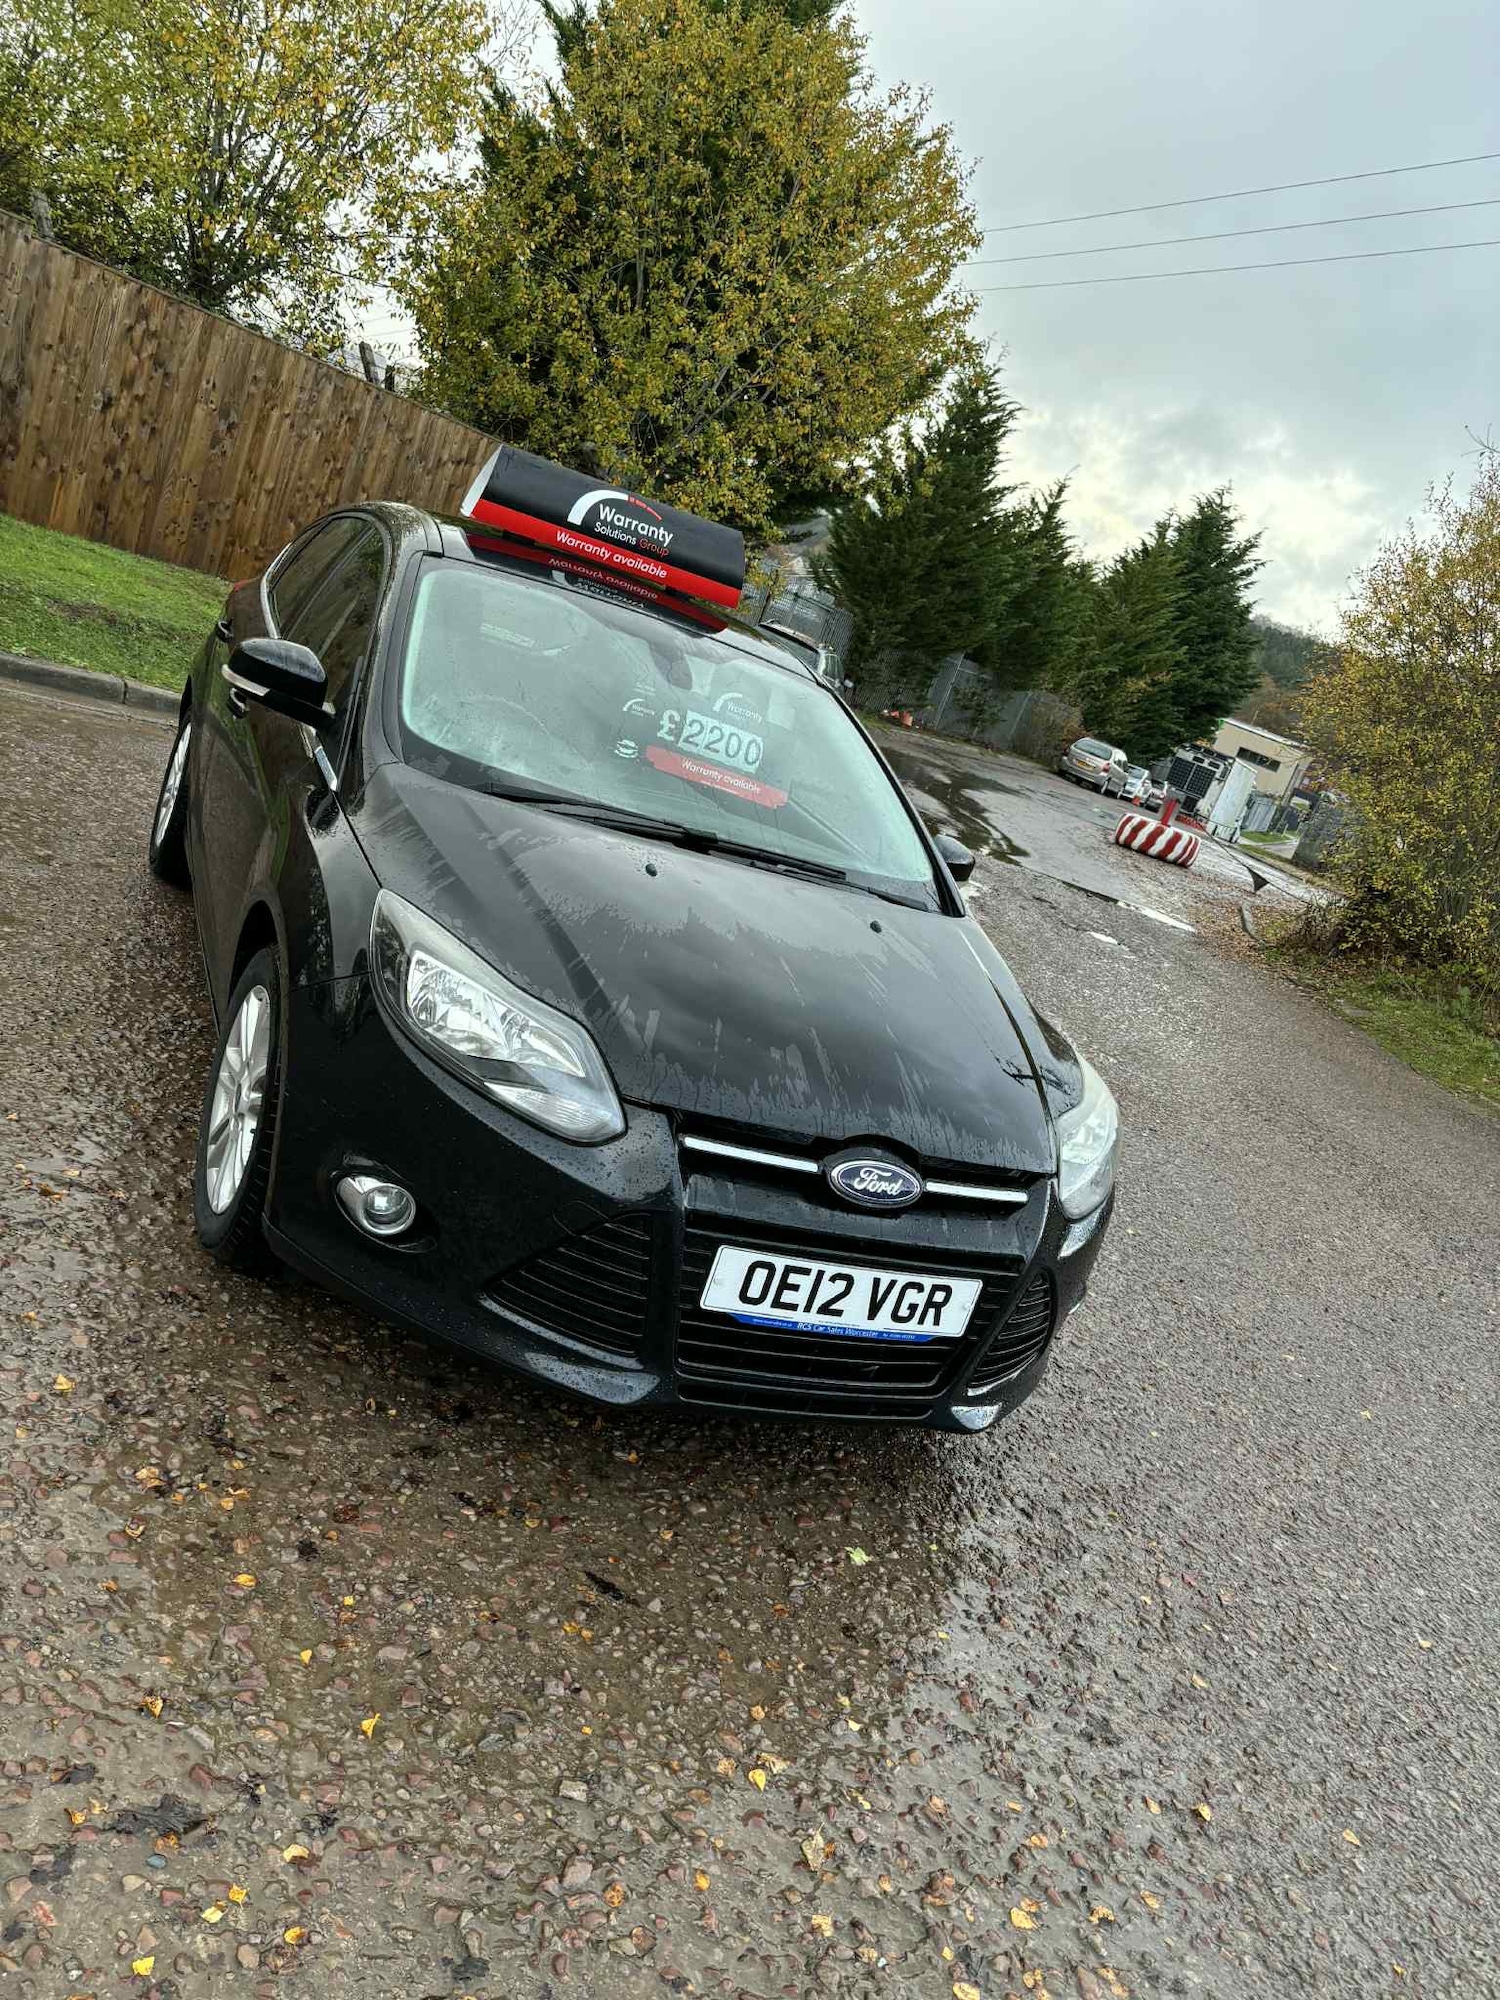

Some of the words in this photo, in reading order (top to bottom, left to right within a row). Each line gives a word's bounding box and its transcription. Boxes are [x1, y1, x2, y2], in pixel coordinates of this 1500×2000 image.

[594, 522, 638, 546] Solutions
[638, 538, 670, 559] Group
[598, 503, 674, 547] Warranty
[556, 531, 610, 561] Warranty
[613, 551, 668, 579] available
[727, 701, 763, 724] Warranty
[657, 709, 762, 766] £2200
[681, 758, 723, 782] Warranty
[724, 775, 761, 794] available
[852, 1167, 904, 1196] Ford
[738, 1260, 855, 1318] OE12
[866, 1276, 954, 1327] VGR
[813, 1323, 825, 1332] Car
[827, 1325, 844, 1336] Sales
